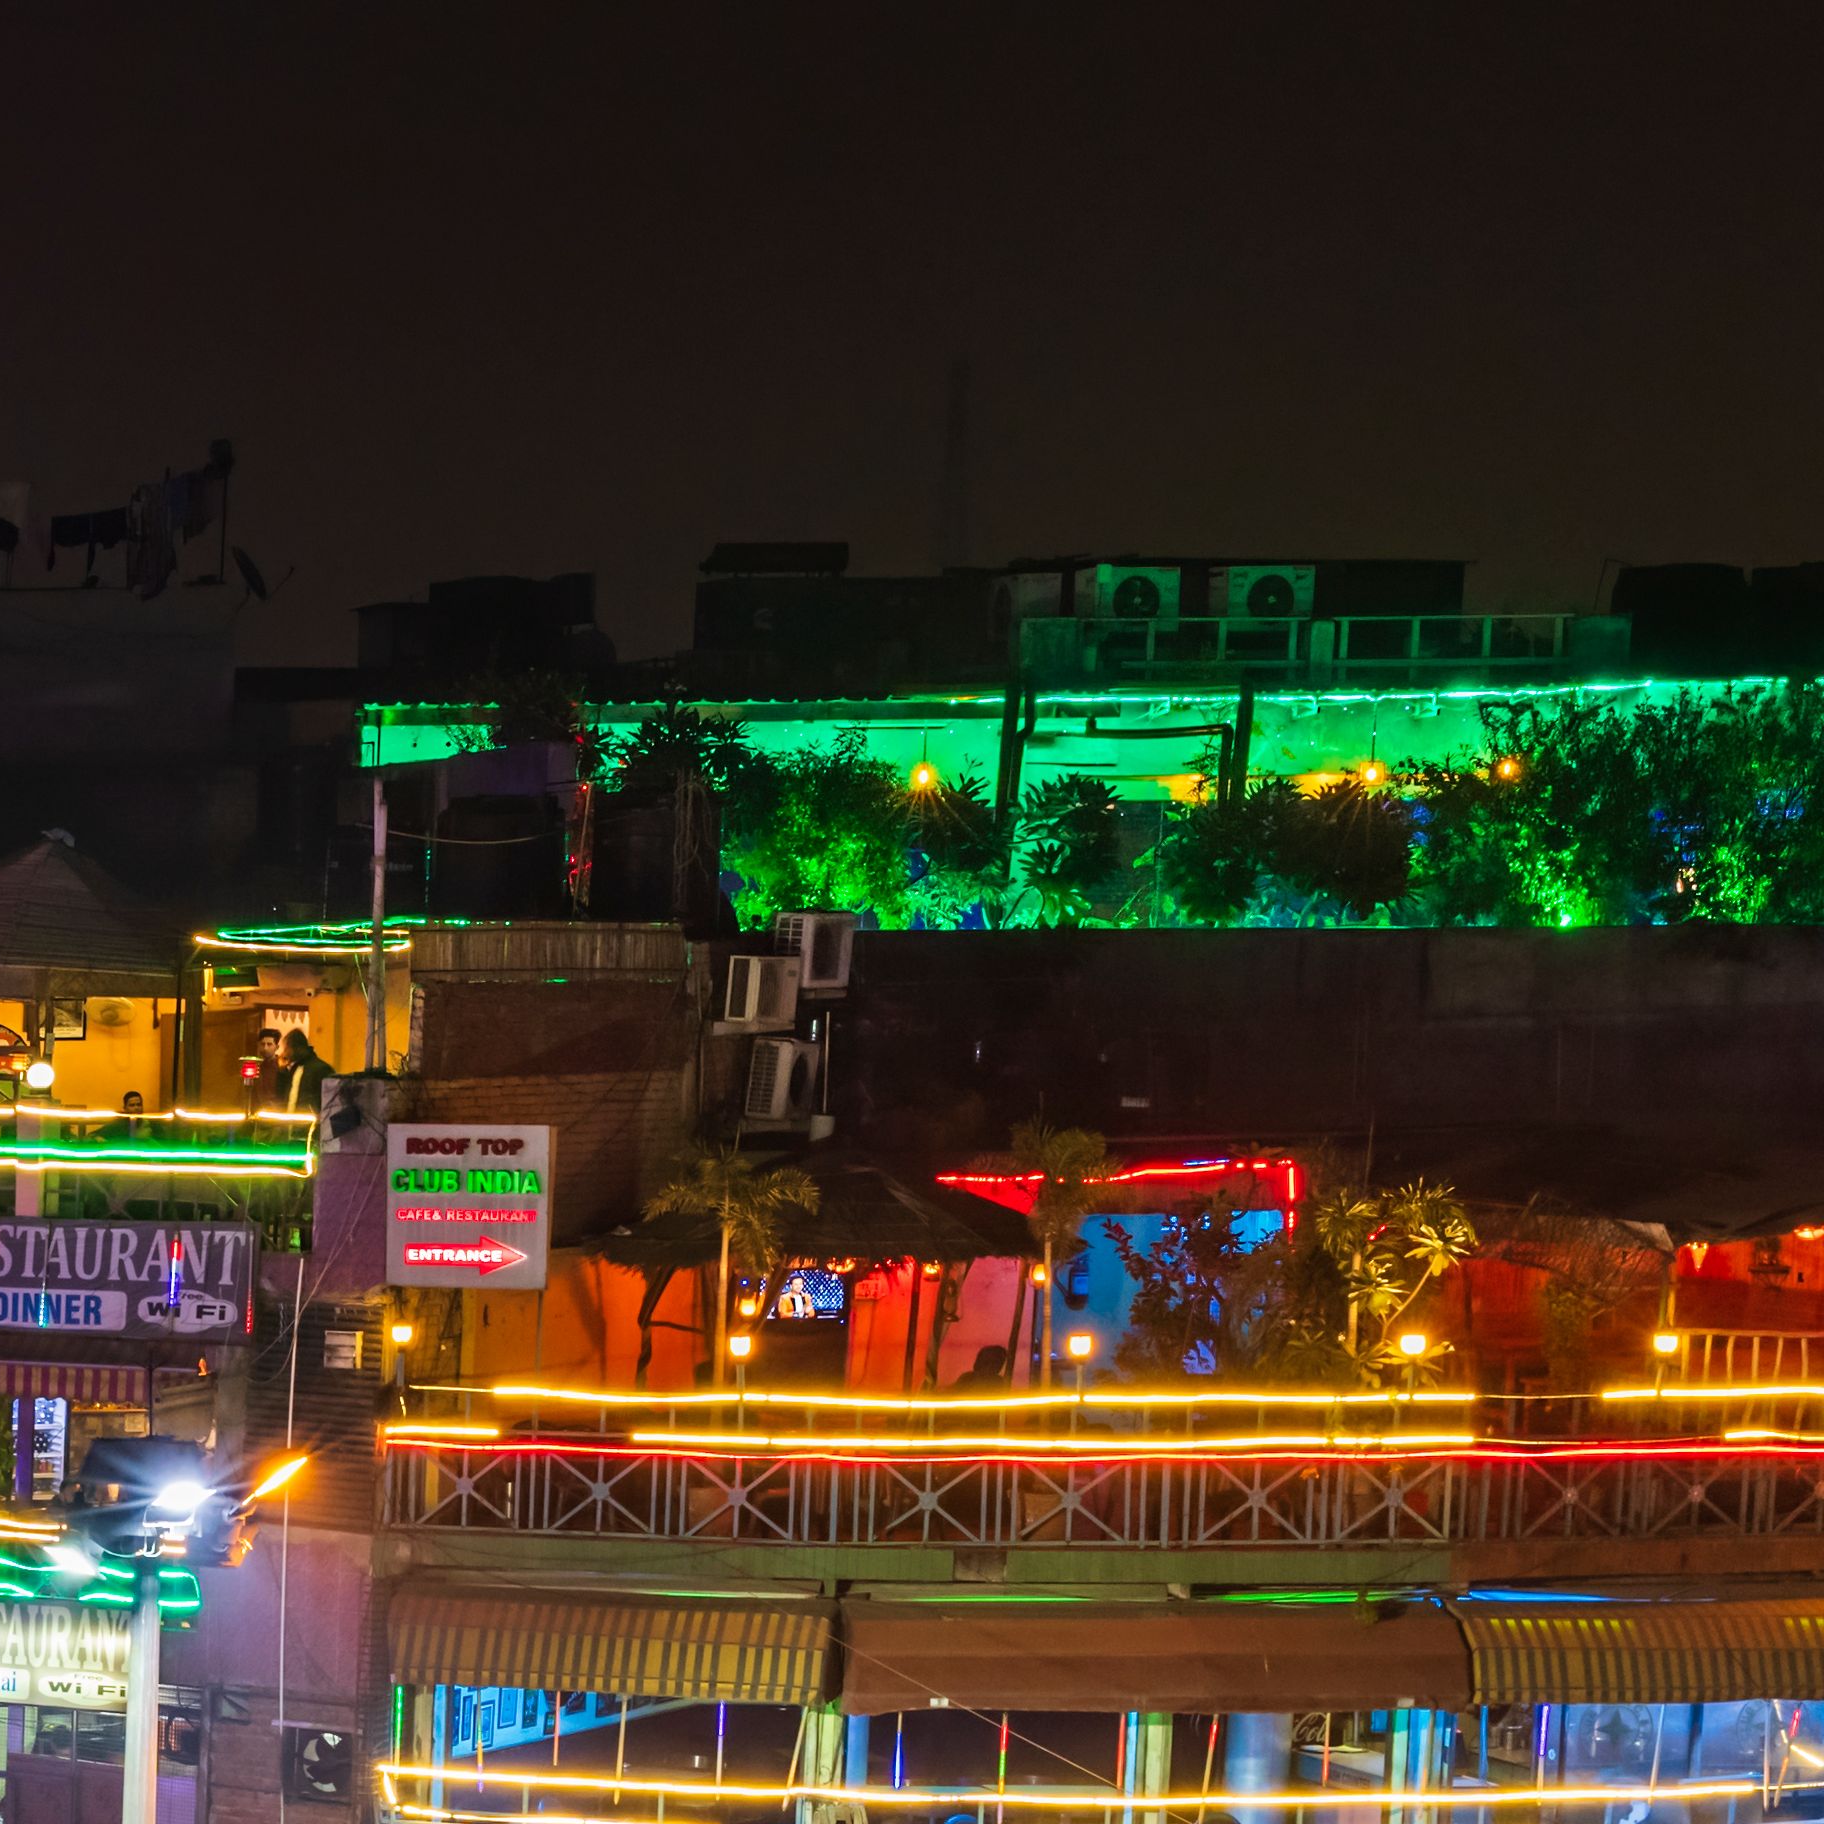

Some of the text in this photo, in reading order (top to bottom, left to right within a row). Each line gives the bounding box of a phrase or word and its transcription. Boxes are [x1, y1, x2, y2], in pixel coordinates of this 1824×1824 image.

[406, 1138, 524, 1155] ROOF TOP
[392, 1169, 541, 1194] CLUB INDIA
[446, 1210, 537, 1222] RESTAURANT
[408, 1249, 502, 1262] ENTRANCE
